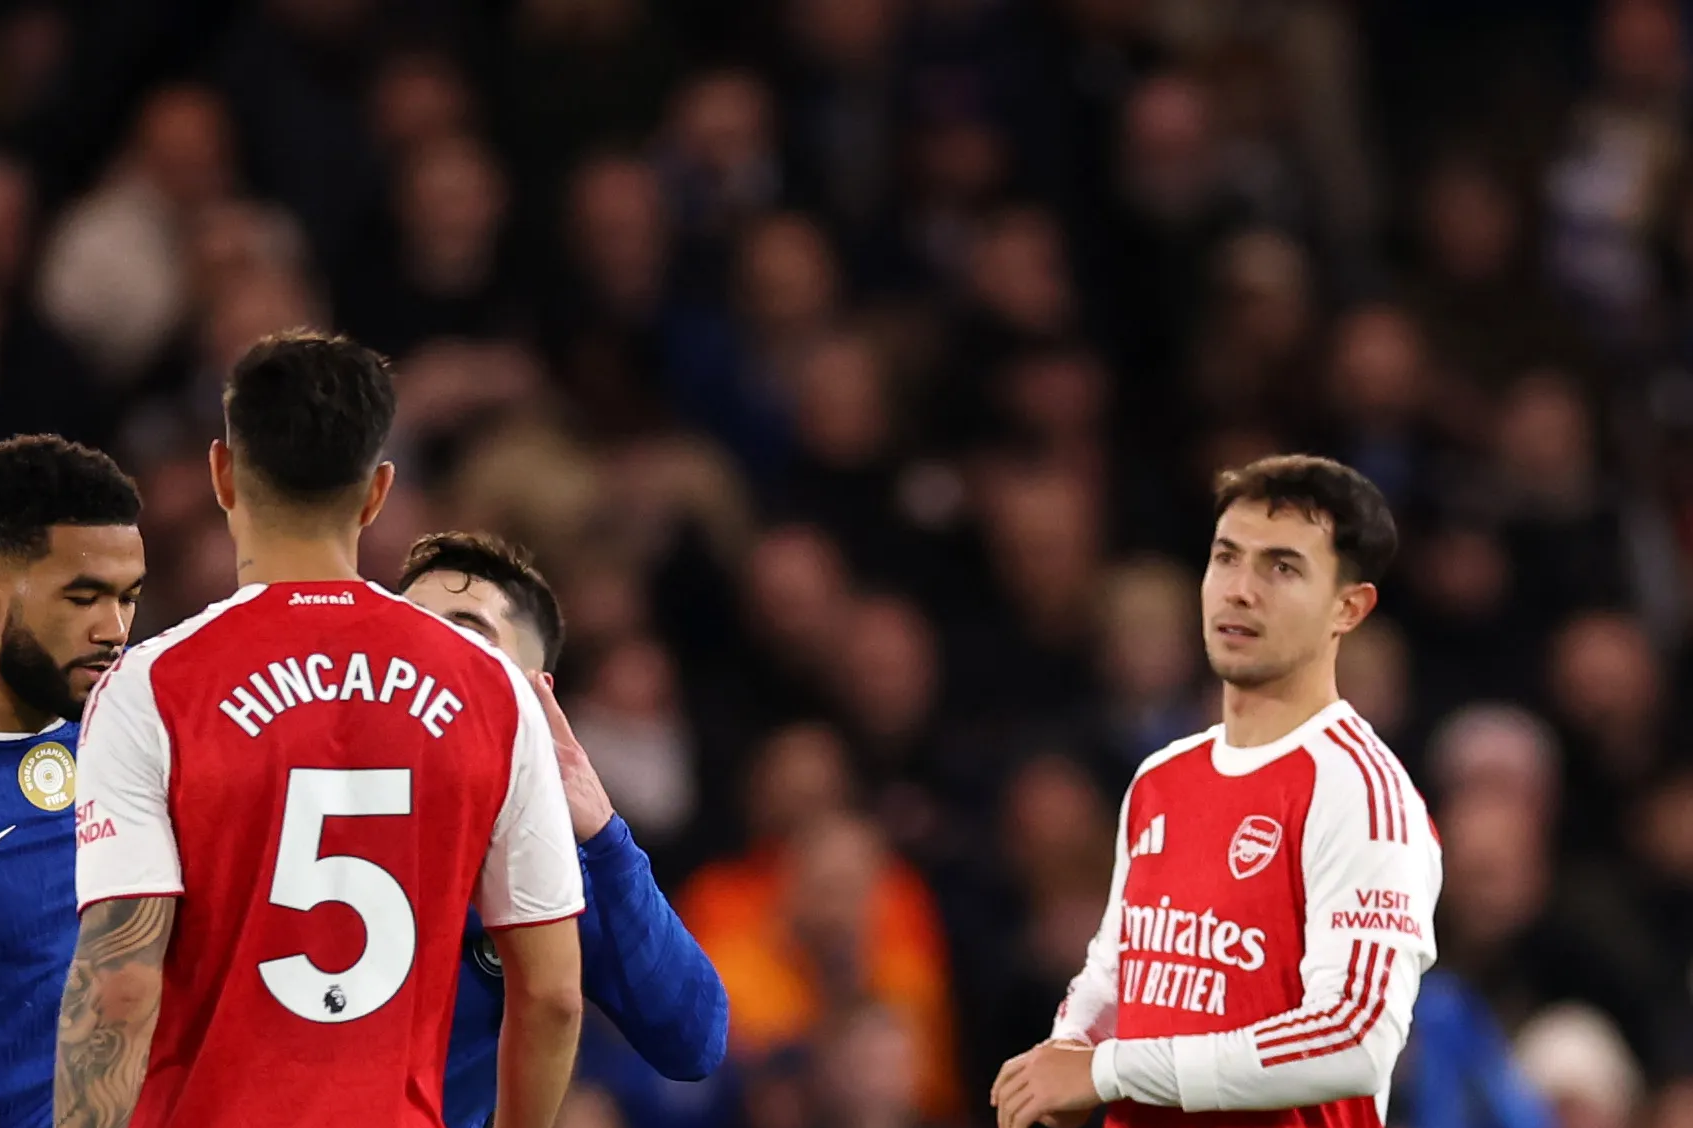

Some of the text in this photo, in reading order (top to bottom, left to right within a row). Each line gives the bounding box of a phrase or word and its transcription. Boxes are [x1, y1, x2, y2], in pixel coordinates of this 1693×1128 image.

[287, 590, 356, 606] Arsenal
[218, 652, 464, 739] HINCAPIE
[23, 748, 74, 792] WORLD CHAMPIONS
[44, 791, 69, 807] FIFA
[75, 799, 95, 827] SIT
[76, 817, 118, 848] NDA
[257, 767, 417, 1024] 5
[1355, 888, 1410, 911] VISIT
[1140, 960, 1227, 1017] BETTER
